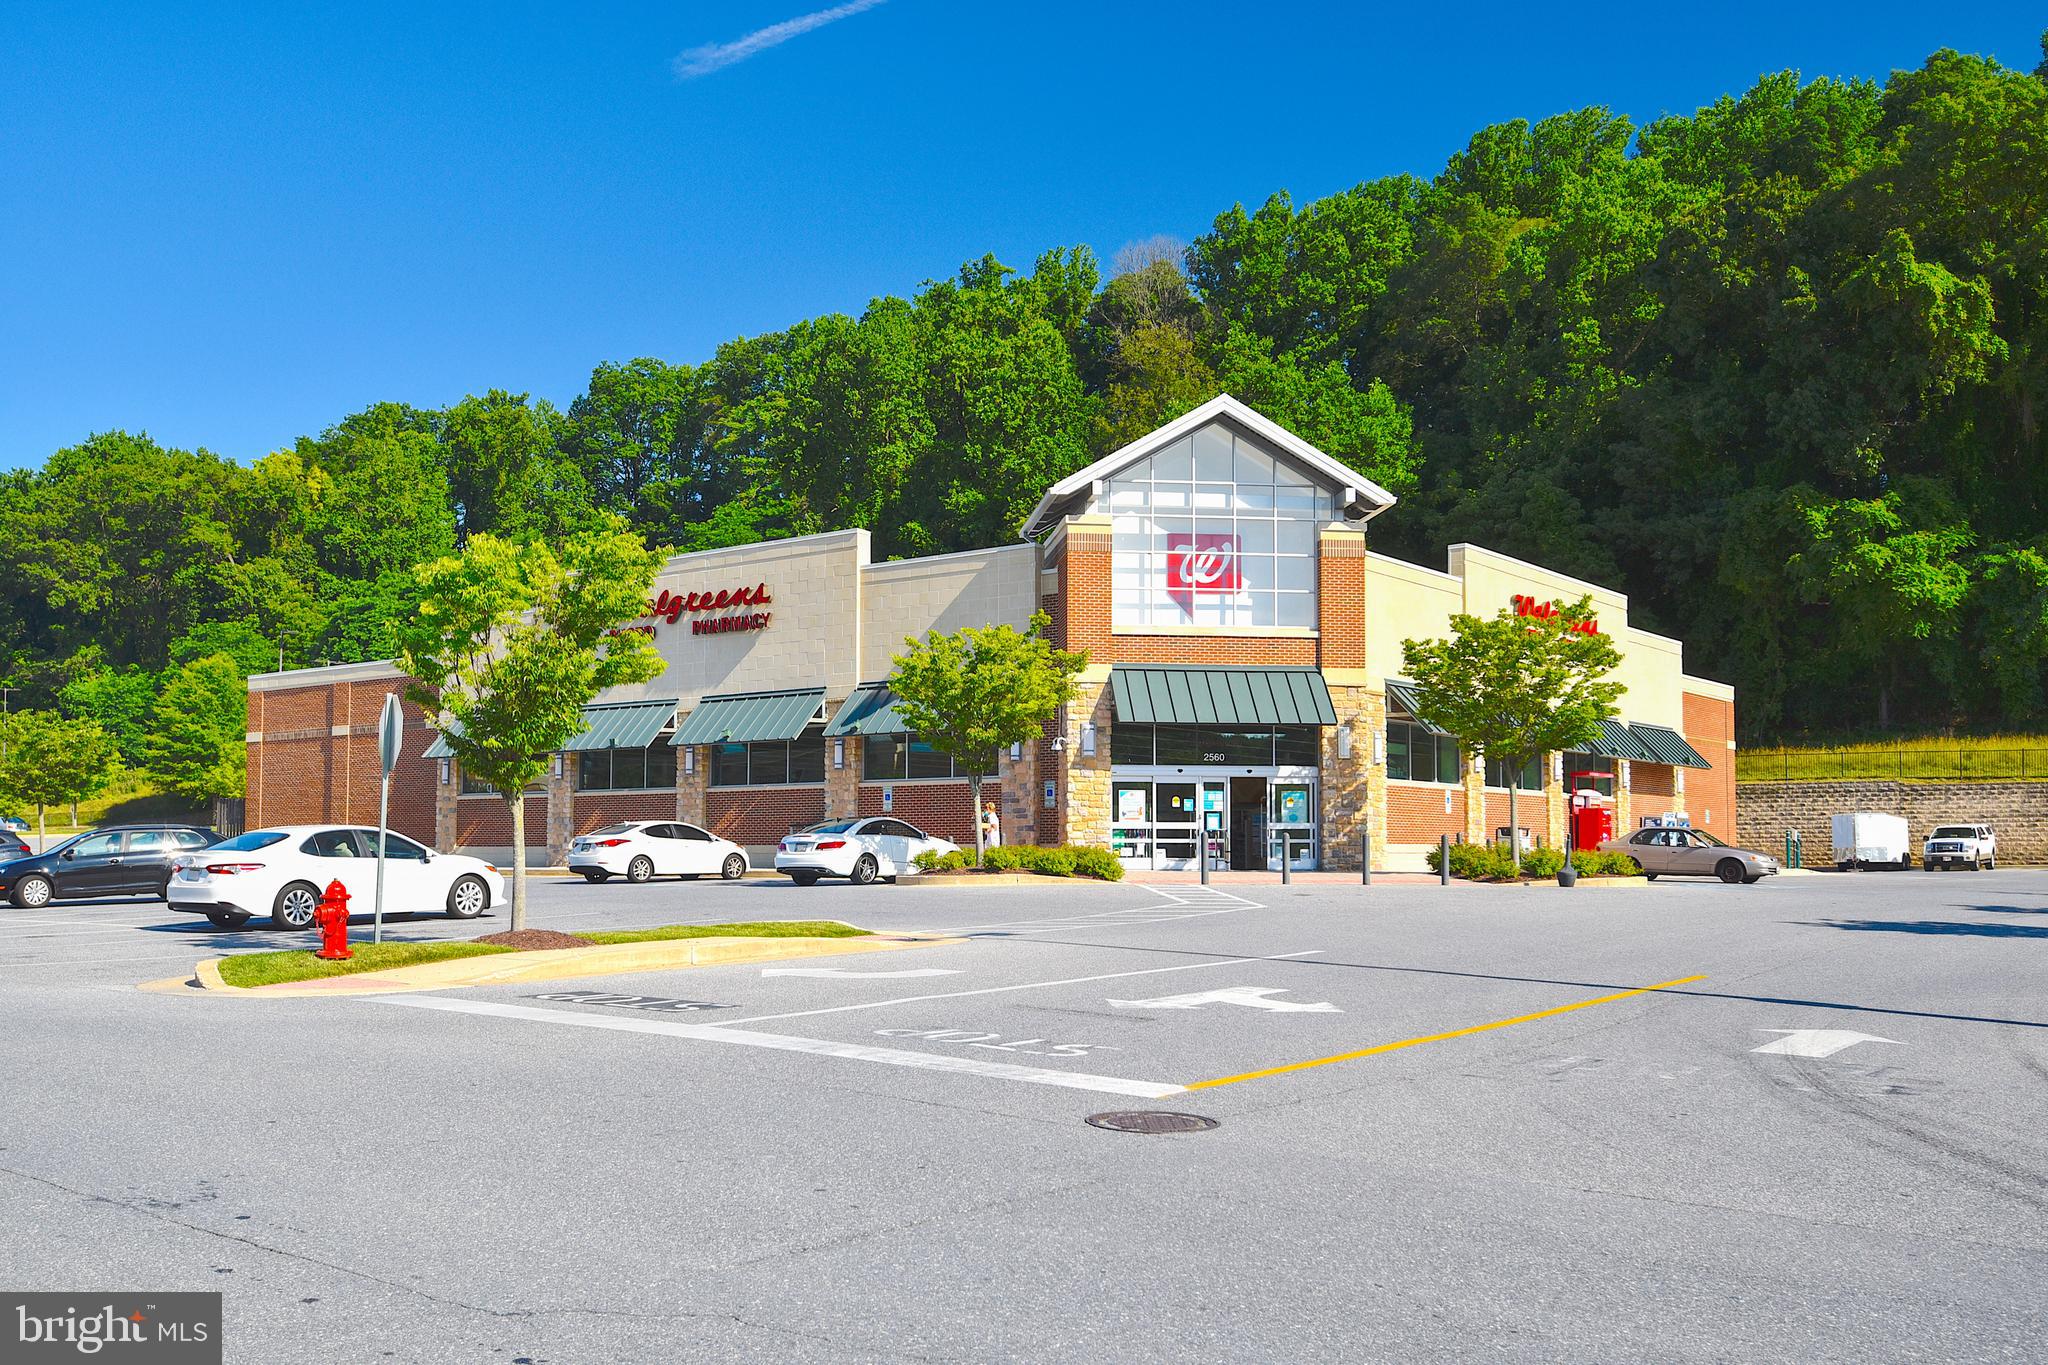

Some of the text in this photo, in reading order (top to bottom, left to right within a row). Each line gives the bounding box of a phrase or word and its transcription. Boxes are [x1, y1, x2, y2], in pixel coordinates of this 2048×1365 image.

[640, 582, 771, 625] lgreens
[692, 612, 771, 635] PHARMACY
[1203, 753, 1225, 762] 2560
[536, 993, 735, 1012] STOP
